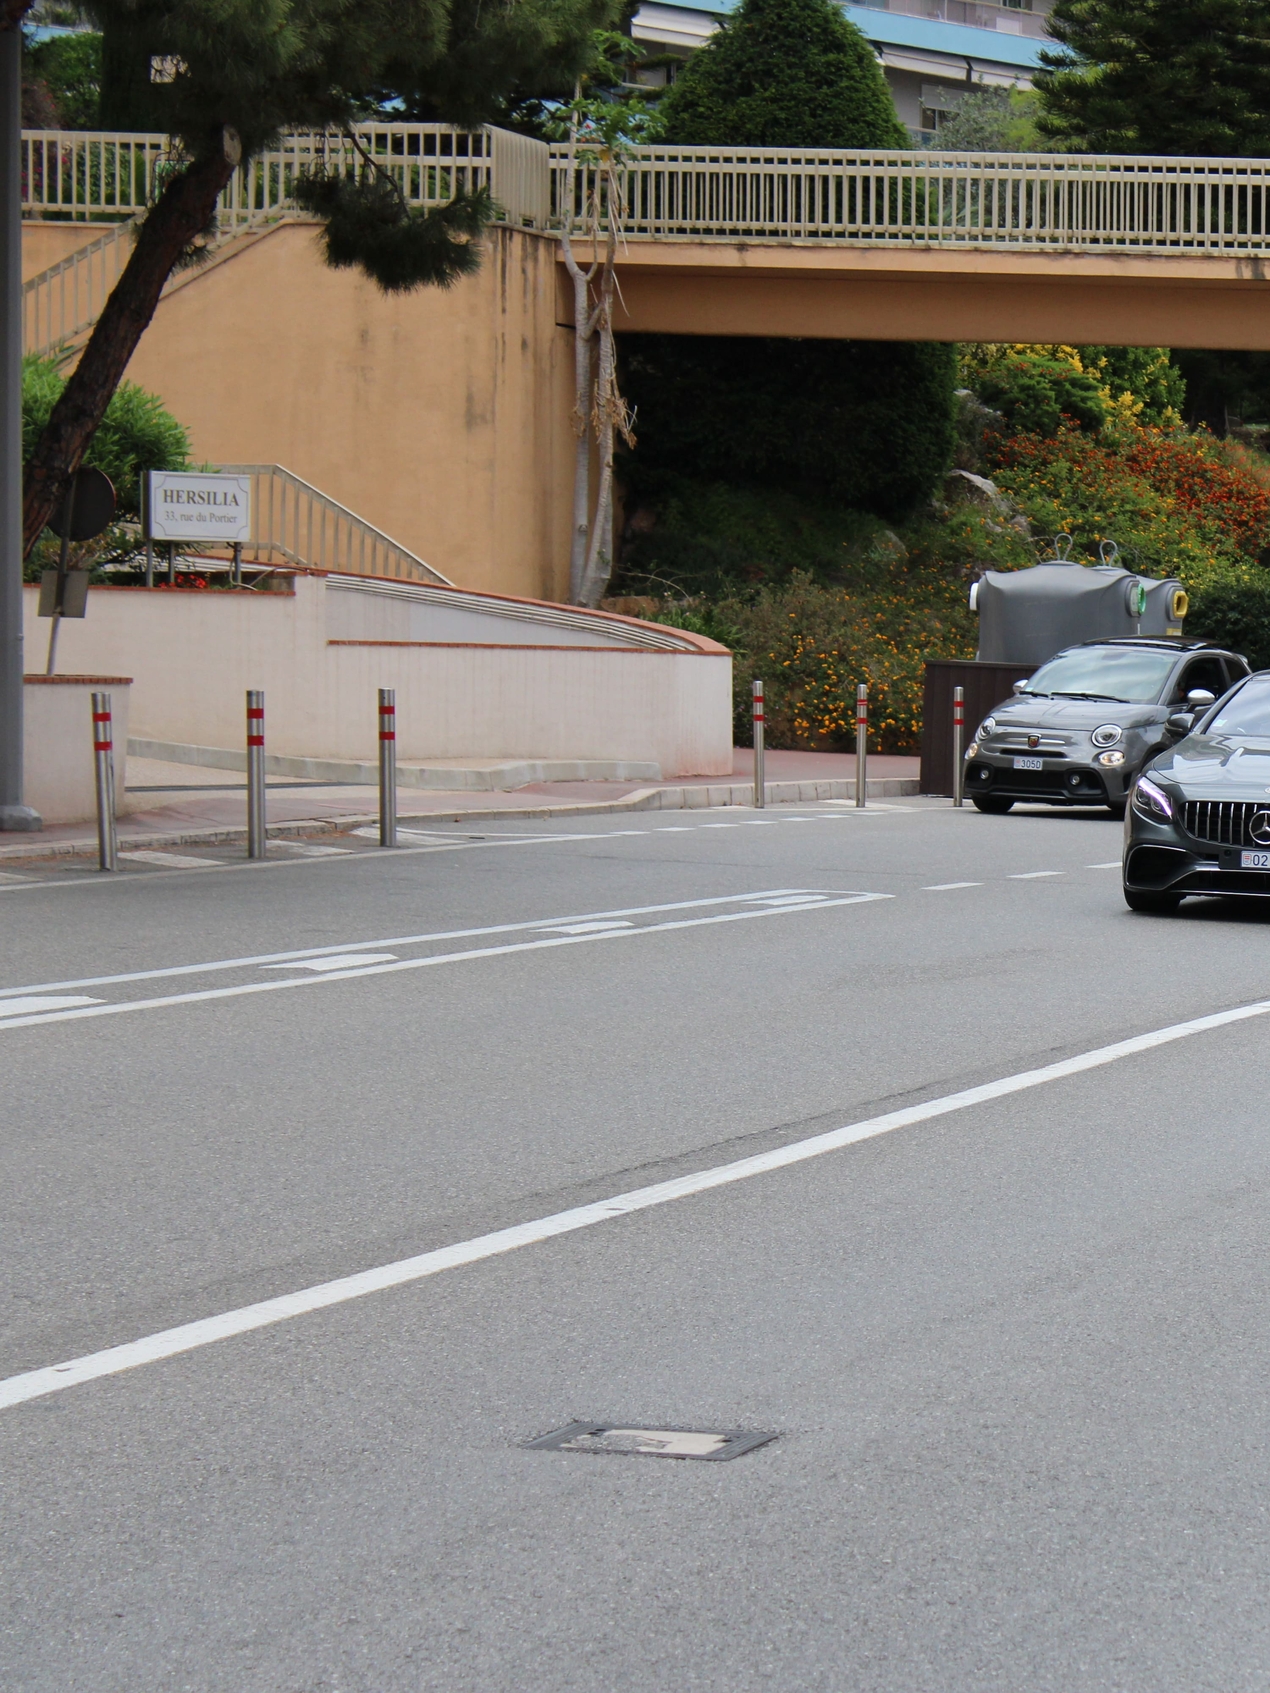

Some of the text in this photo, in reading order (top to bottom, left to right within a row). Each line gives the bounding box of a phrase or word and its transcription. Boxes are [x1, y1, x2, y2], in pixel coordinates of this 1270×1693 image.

[163, 489, 240, 507] HERSILIA
[164, 510, 237, 523] 33, rue du Portier
